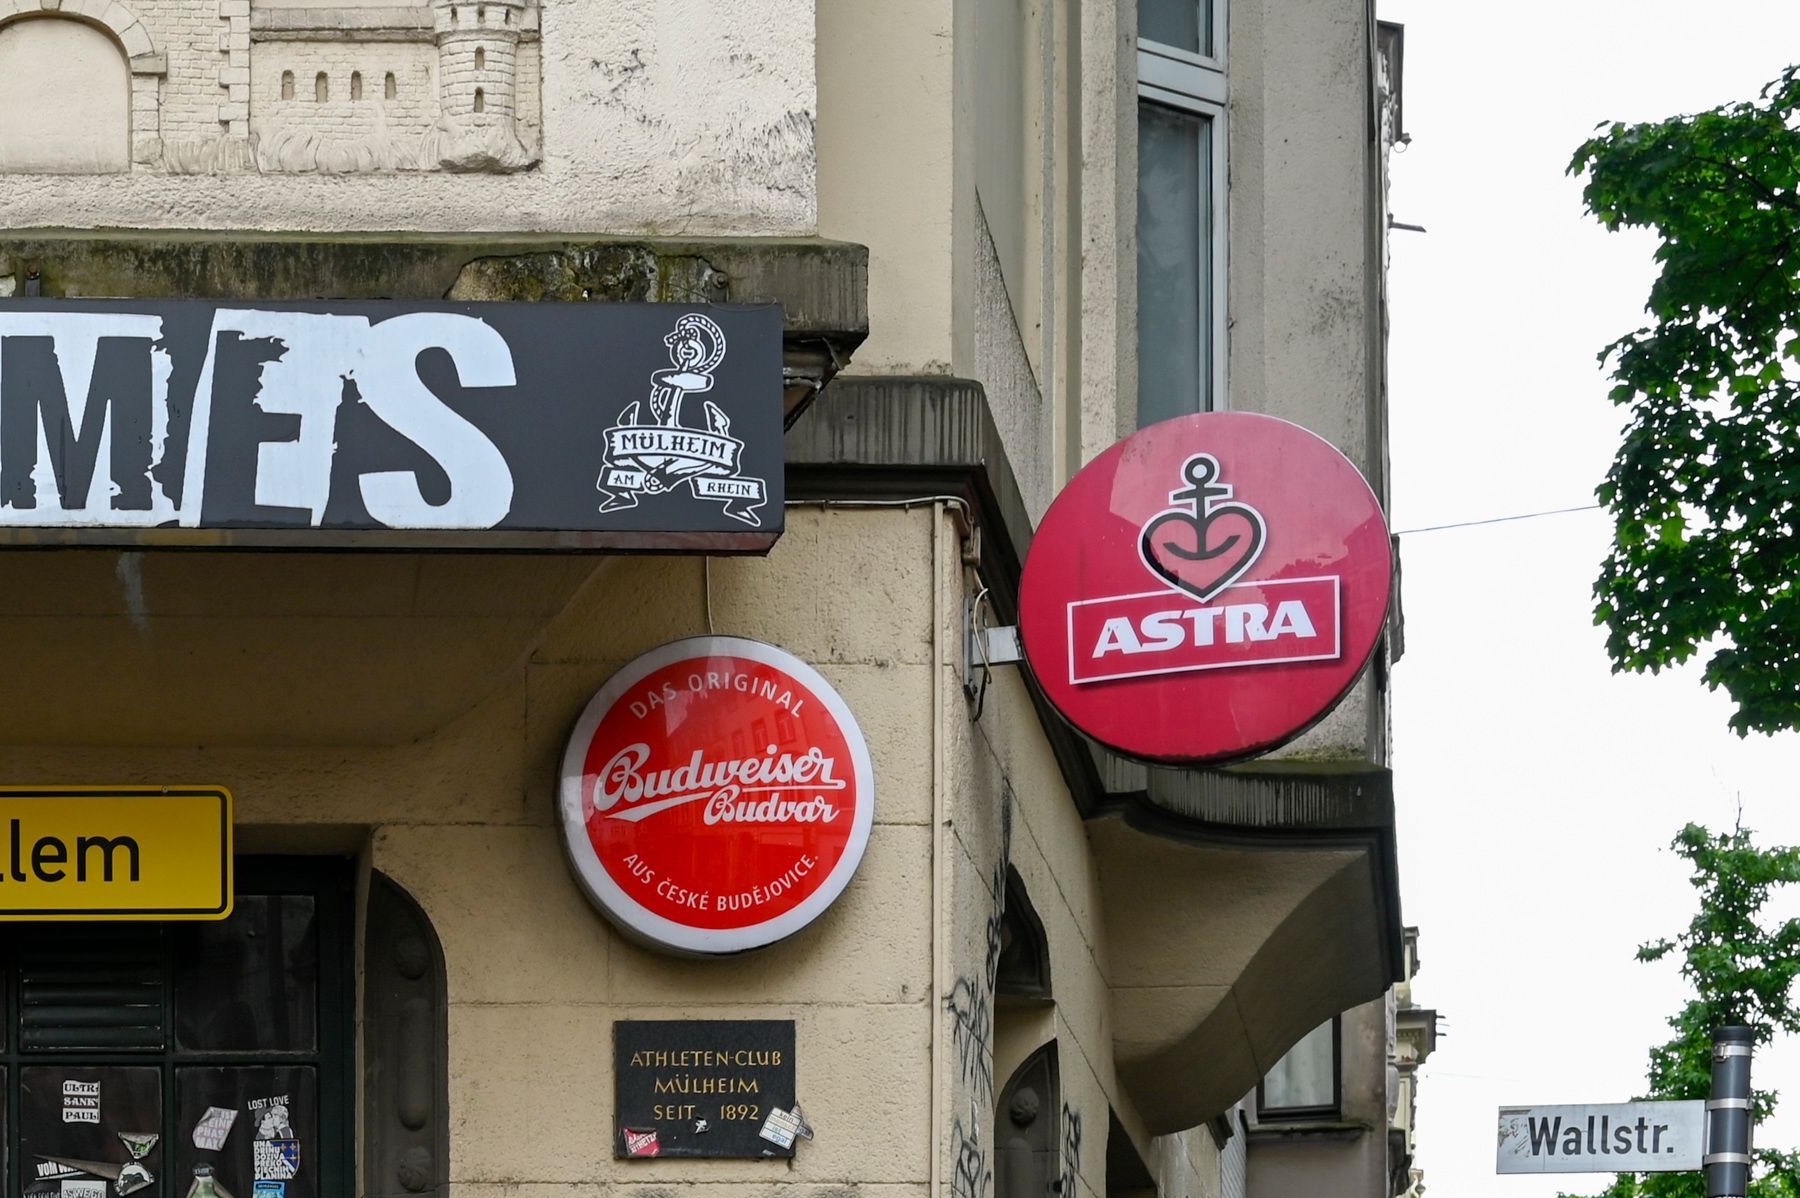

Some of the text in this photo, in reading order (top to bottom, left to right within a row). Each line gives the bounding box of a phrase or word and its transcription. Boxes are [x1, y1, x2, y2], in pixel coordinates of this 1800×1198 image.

[621, 431, 727, 460] MÜLHEIM
[613, 474, 752, 496] AM RHEIN
[1091, 600, 1317, 659] ASTRA
[629, 671, 805, 719] DAS ORIGINAL
[593, 742, 846, 811] Budweiser
[703, 784, 840, 825] Budvar
[623, 852, 656, 884] AUS
[656, 876, 710, 910] ČESKÉ
[630, 1050, 782, 1068] ATHLETEN-CLUB
[654, 1073, 759, 1094] MÜLHEIM
[248, 1094, 290, 1111] LOST LOVE
[654, 1104, 759, 1120] SEIT 1892
[1528, 1114, 1674, 1156] Wallstr.
